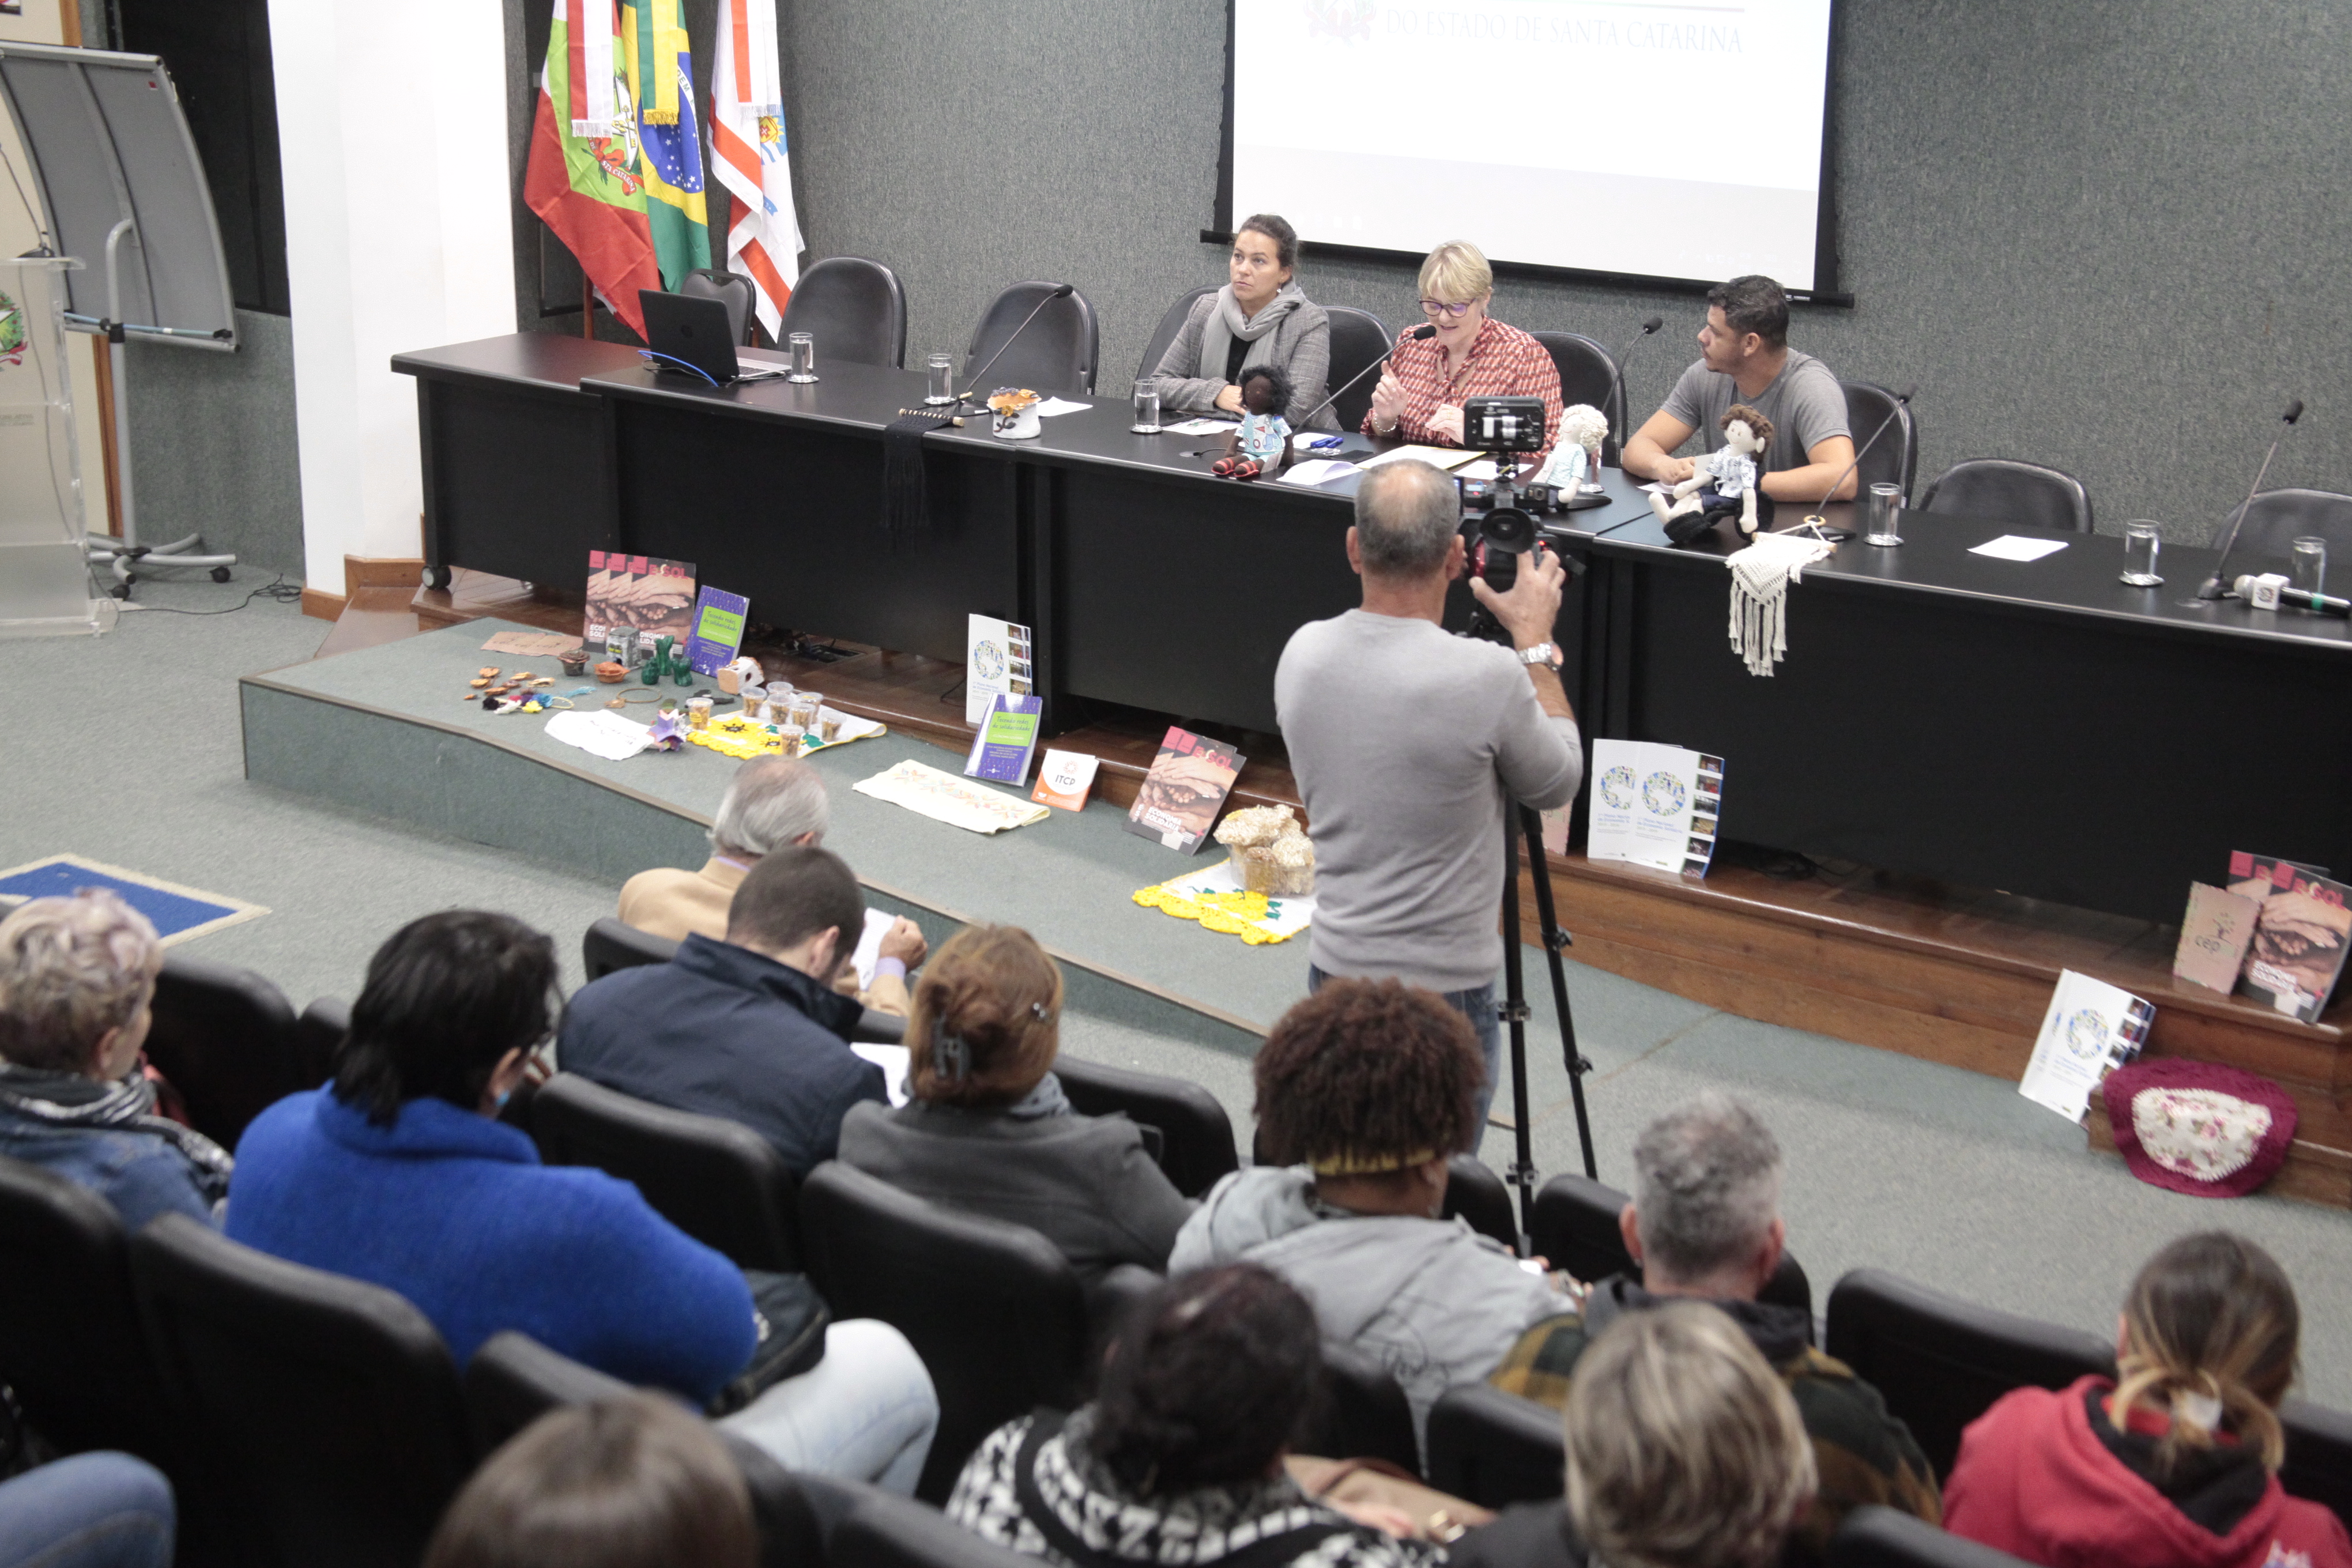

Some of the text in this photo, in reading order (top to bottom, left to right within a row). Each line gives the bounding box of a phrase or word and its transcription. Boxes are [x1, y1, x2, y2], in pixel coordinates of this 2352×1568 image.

[1386, 9, 1742, 52] DO ESTADO DE SANTA CATARINA
[601, 160, 612, 172] STA
[612, 169, 636, 192] CATARINA
[1055, 774, 1076, 786] ITCP
[1148, 806, 1182, 826] ECONOMIA
